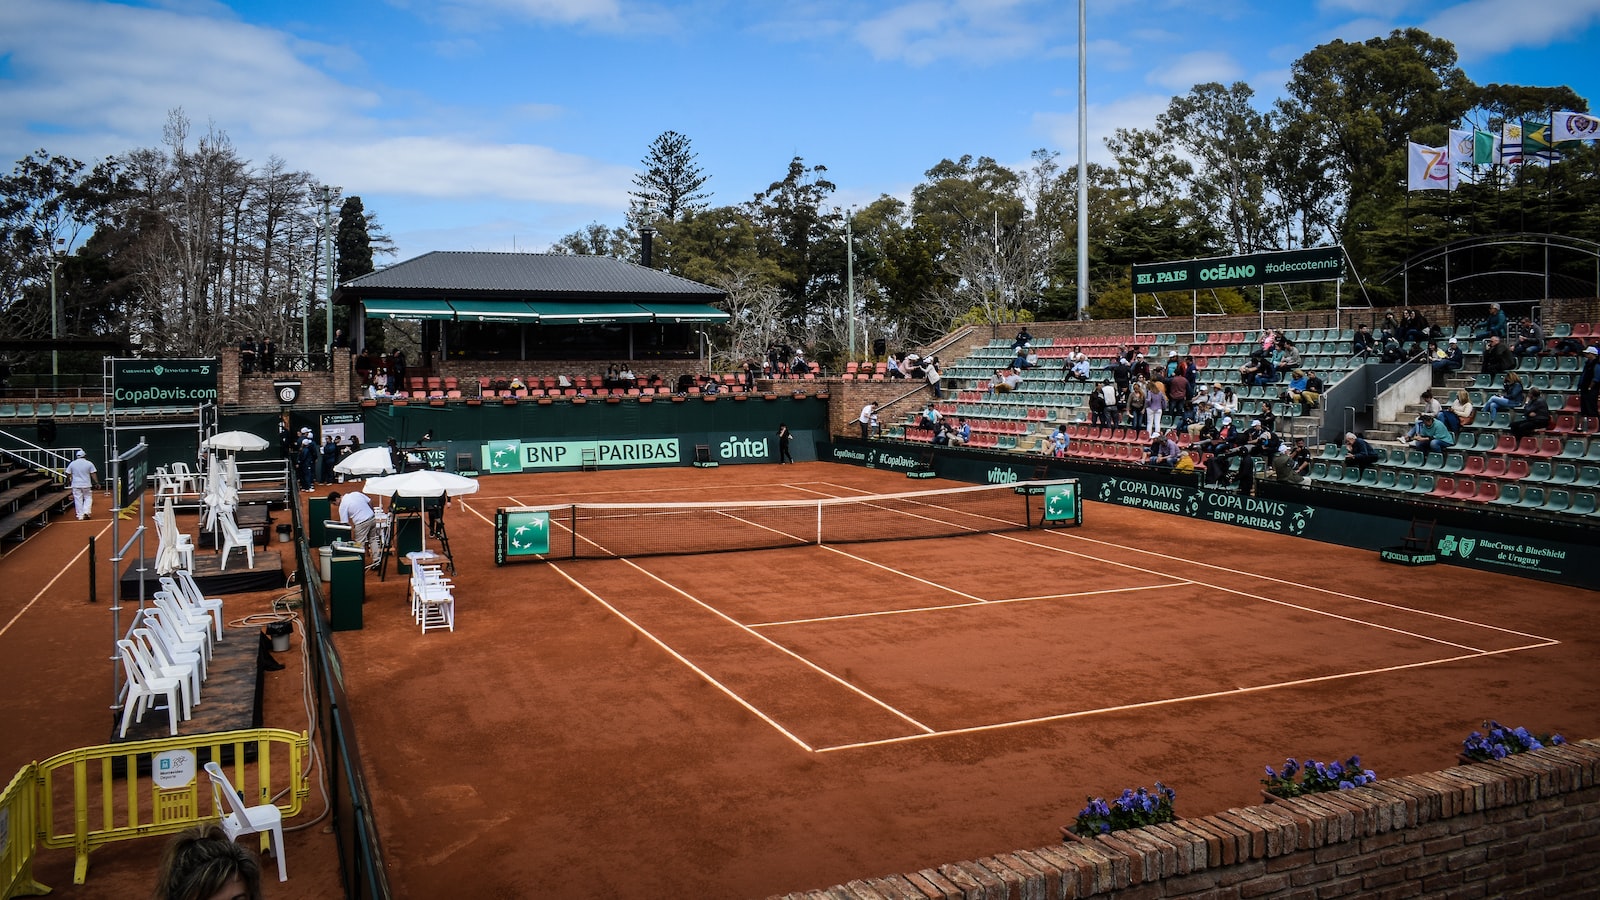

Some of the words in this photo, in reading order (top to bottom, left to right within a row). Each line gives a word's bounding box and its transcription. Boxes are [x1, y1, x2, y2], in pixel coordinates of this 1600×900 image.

[1136, 273, 1155, 285] EL
[1156, 269, 1188, 283] PAIS
[1264, 256, 1339, 274] #adeccotennis
[114, 386, 217, 404] CopaDavis.com
[526, 446, 567, 463] BNP
[599, 442, 677, 461] PARIBAS
[719, 436, 769, 459] antel
[833, 448, 865, 460] CopaDavis.com
[879, 453, 914, 468] #CopaDavis
[987, 466, 1018, 484] vitale
[1119, 480, 1148, 495] COPA
[1150, 484, 1183, 500] DAVIS
[1123, 495, 1142, 506] BNP
[1142, 498, 1180, 513] PARIBAS
[1208, 493, 1243, 510] COPA
[1246, 498, 1286, 517] DAVIS
[1213, 510, 1235, 522] BNP
[1236, 514, 1282, 531] PARIBAS
[1479, 539, 1515, 552] BlueCross
[1516, 545, 1523, 553] &
[1525, 546, 1566, 559] BlueShield
[1497, 552, 1507, 560] de
[1508, 553, 1540, 567] Uruguay
